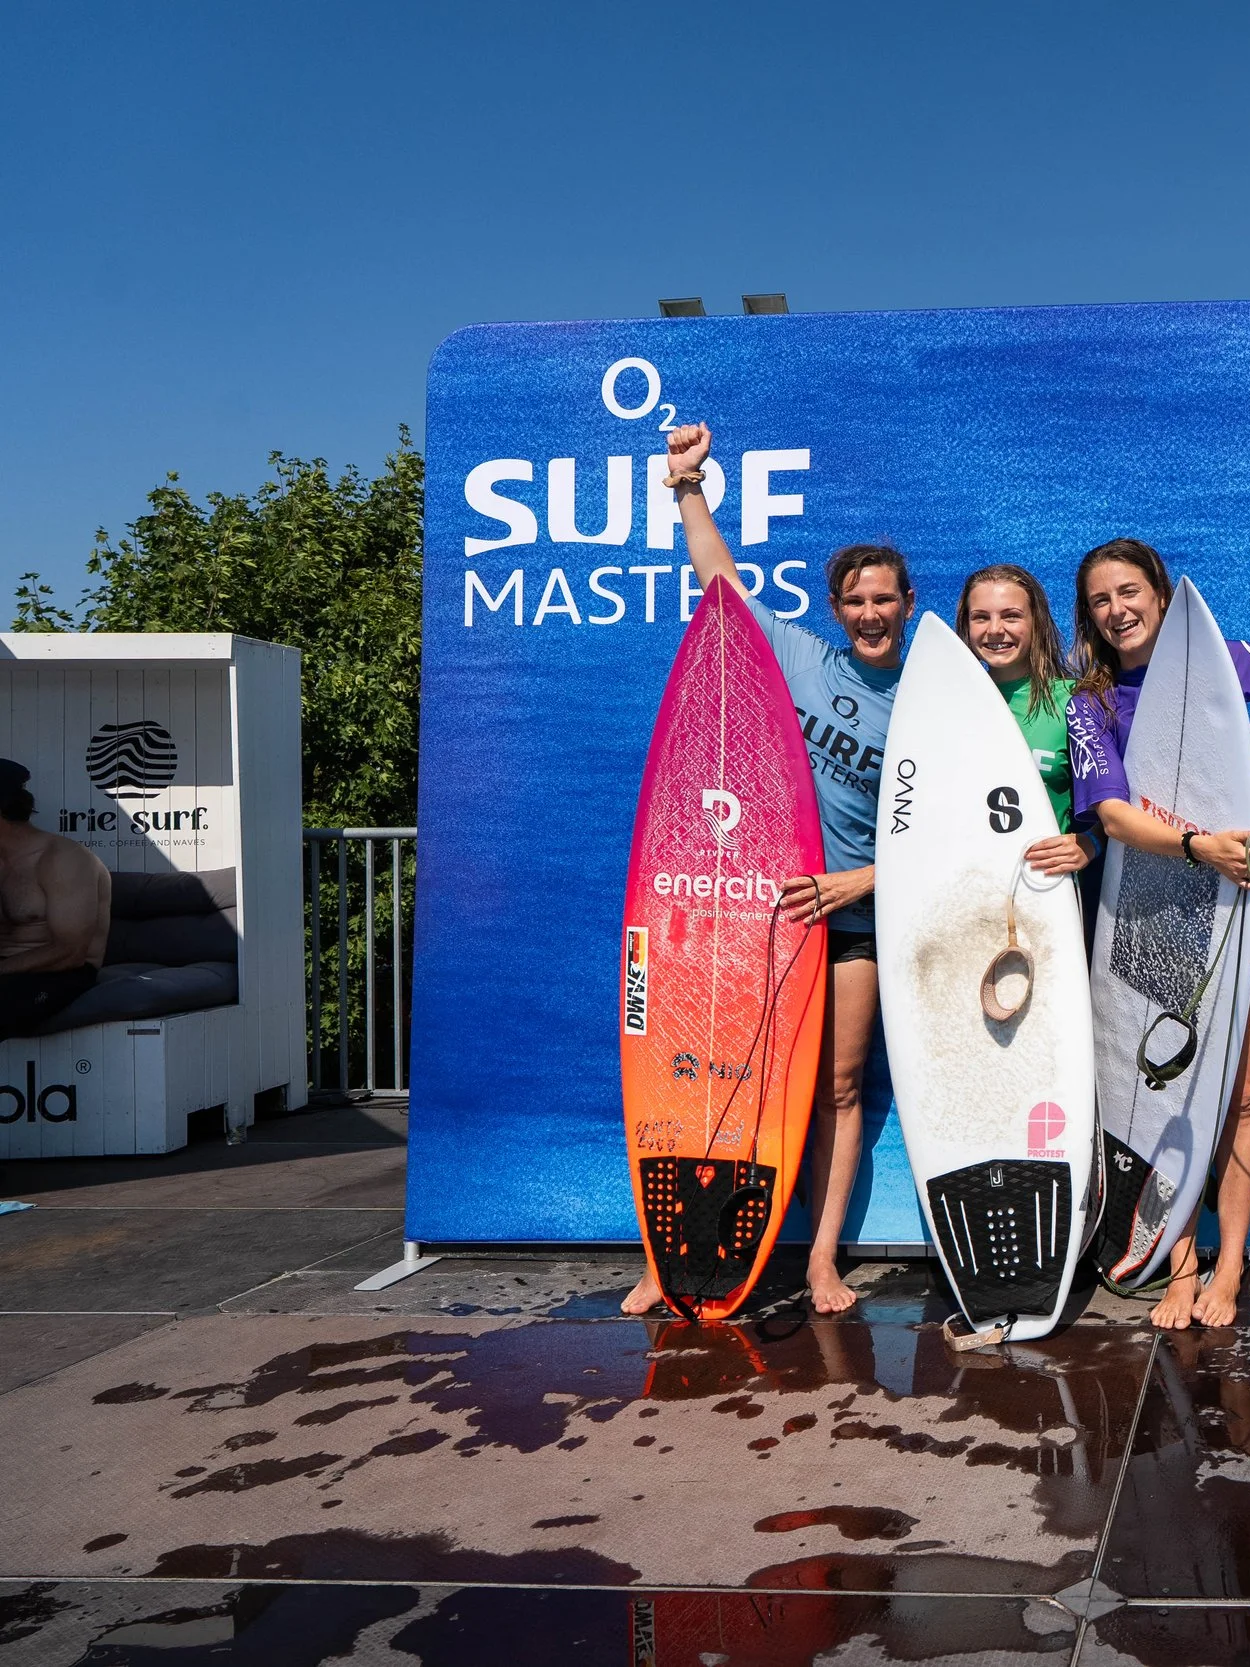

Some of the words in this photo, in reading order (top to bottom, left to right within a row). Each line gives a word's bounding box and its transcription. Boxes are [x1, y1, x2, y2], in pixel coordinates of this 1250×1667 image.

[808, 751, 873, 793] STERS
[59, 808, 117, 832] irie
[109, 840, 147, 848] COFFEE
[653, 869, 784, 908] enercity
[692, 908, 736, 920] positive
[739, 911, 785, 924] energe
[709, 1061, 752, 1081] NIO
[1027, 1150, 1066, 1158] PROTEST
